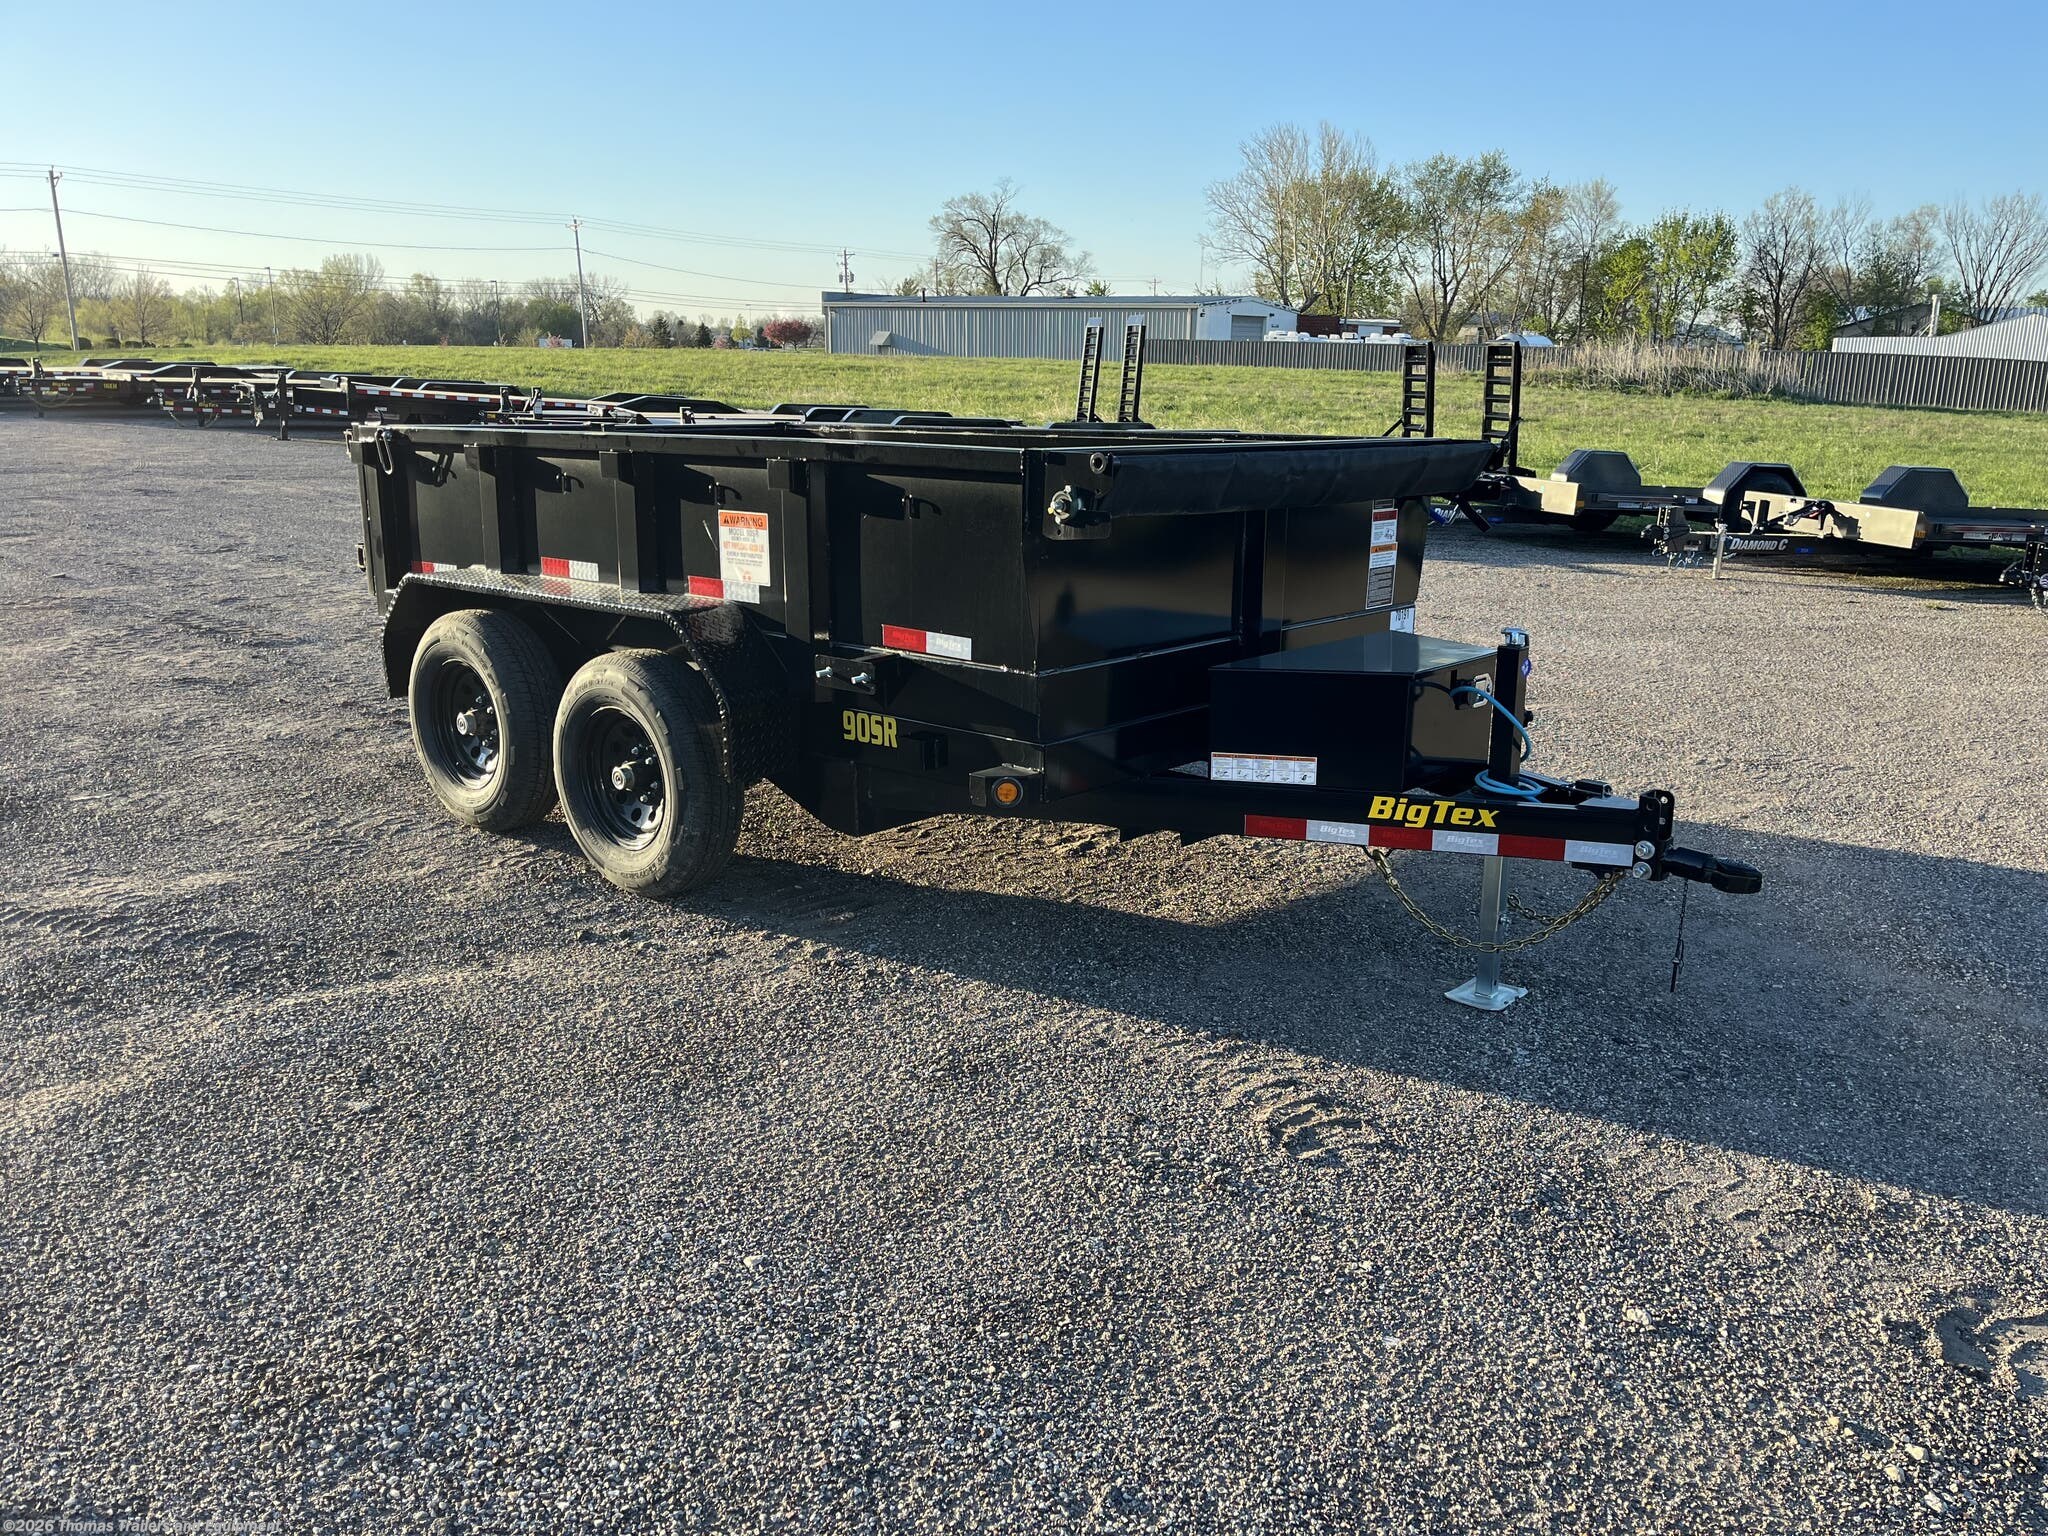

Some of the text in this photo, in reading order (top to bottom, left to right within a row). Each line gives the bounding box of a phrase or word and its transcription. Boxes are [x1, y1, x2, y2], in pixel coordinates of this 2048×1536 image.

[729, 516, 763, 527] WARNING
[1729, 538, 1778, 551] DIAMOND
[1778, 538, 1789, 551] C
[843, 710, 898, 748] 90SR
[1368, 796, 1500, 828] BigTex
[1320, 825, 1356, 835] BigTex
[1446, 835, 1484, 846] BigTex
